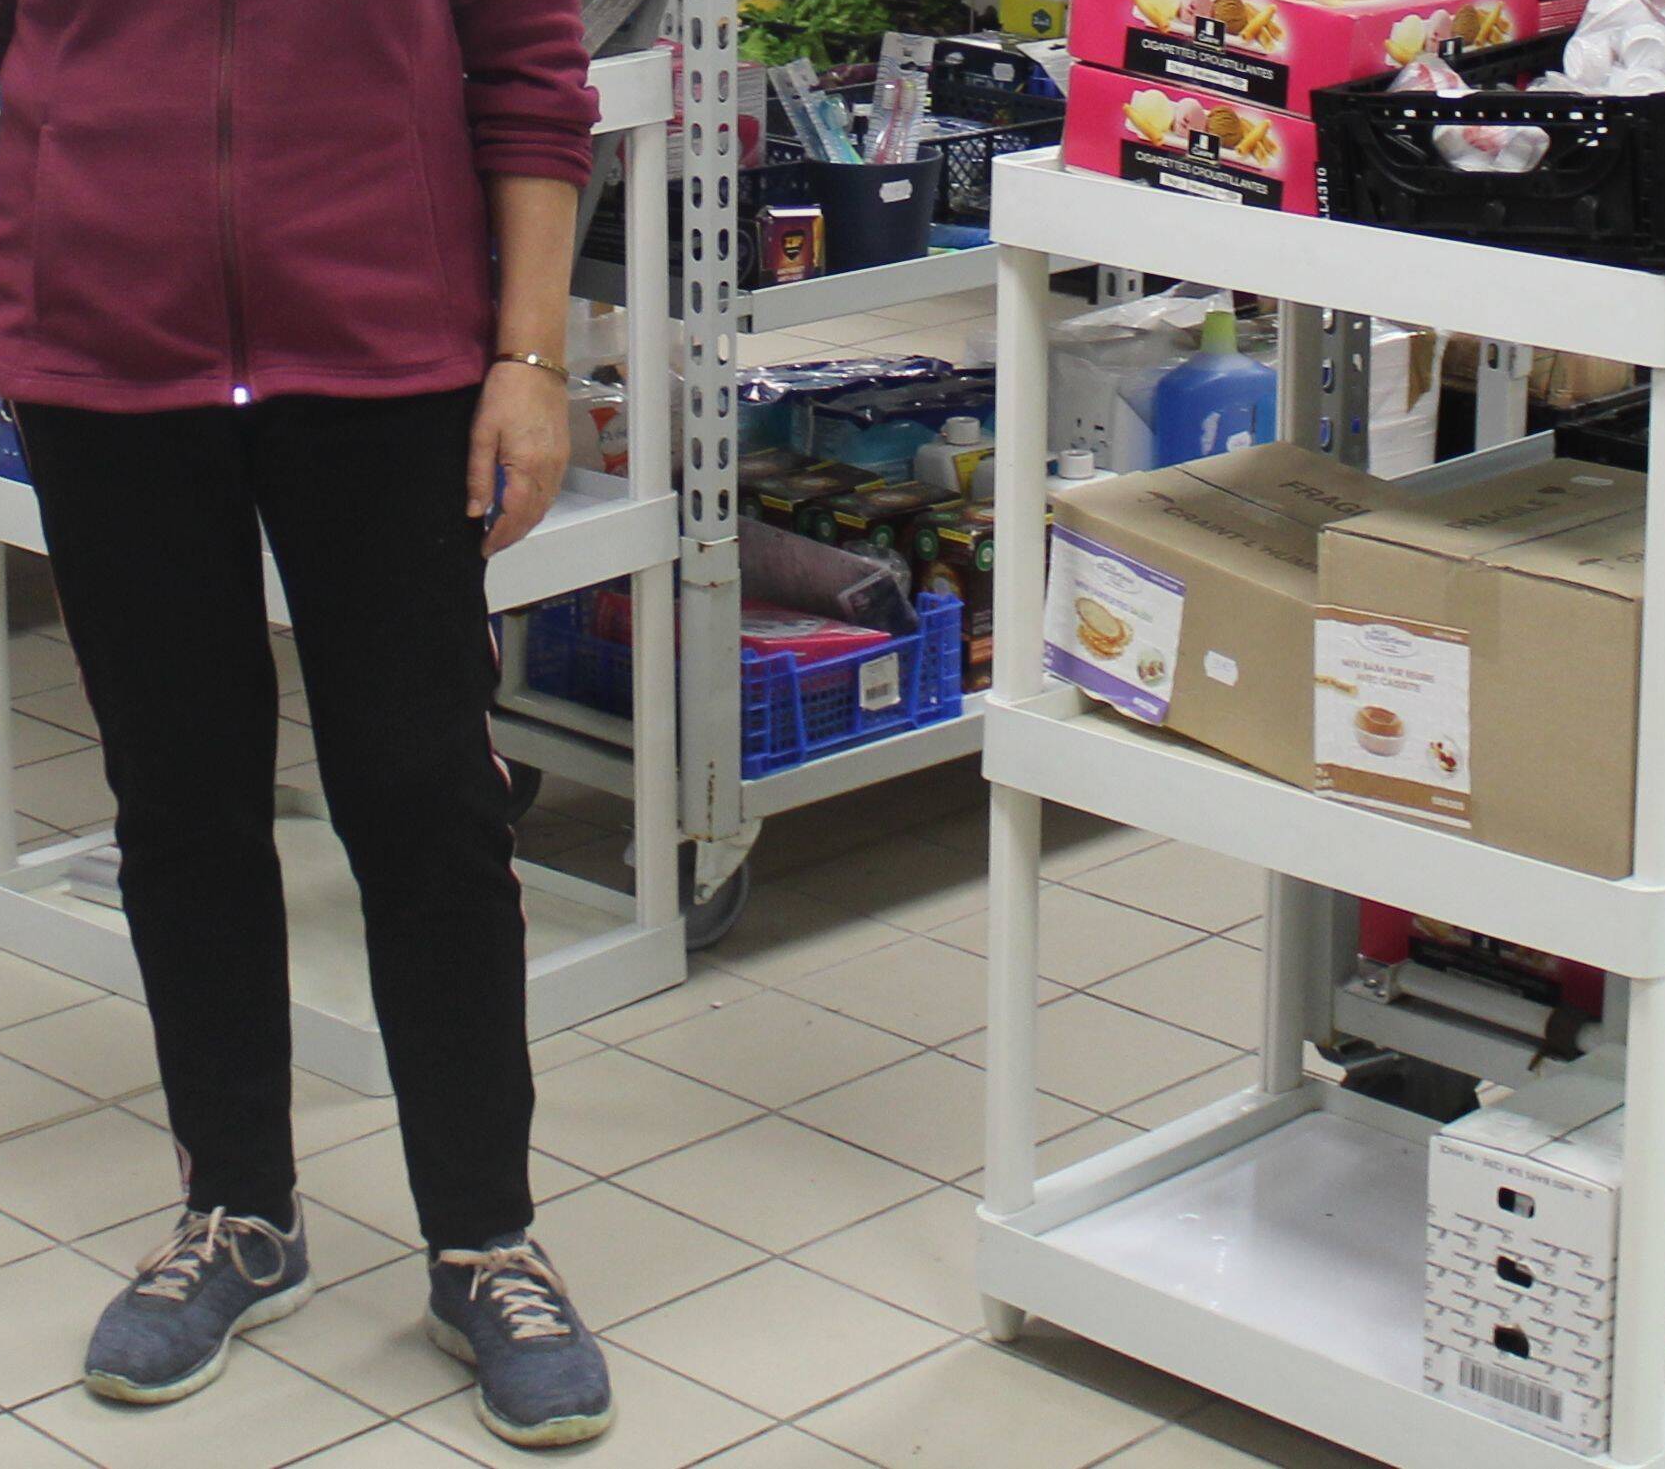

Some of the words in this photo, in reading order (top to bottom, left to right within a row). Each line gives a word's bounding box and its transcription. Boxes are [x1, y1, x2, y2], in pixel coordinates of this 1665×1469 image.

[1140, 38, 1199, 61] CIGARETTES
[1198, 52, 1275, 80] CROUSTILLANTES
[1135, 150, 1192, 174] CIGARETTES
[1191, 165, 1269, 196] CROUSTILLANTES
[1279, 480, 1362, 516] FRAG
[1163, 506, 1245, 541] CRAINT
